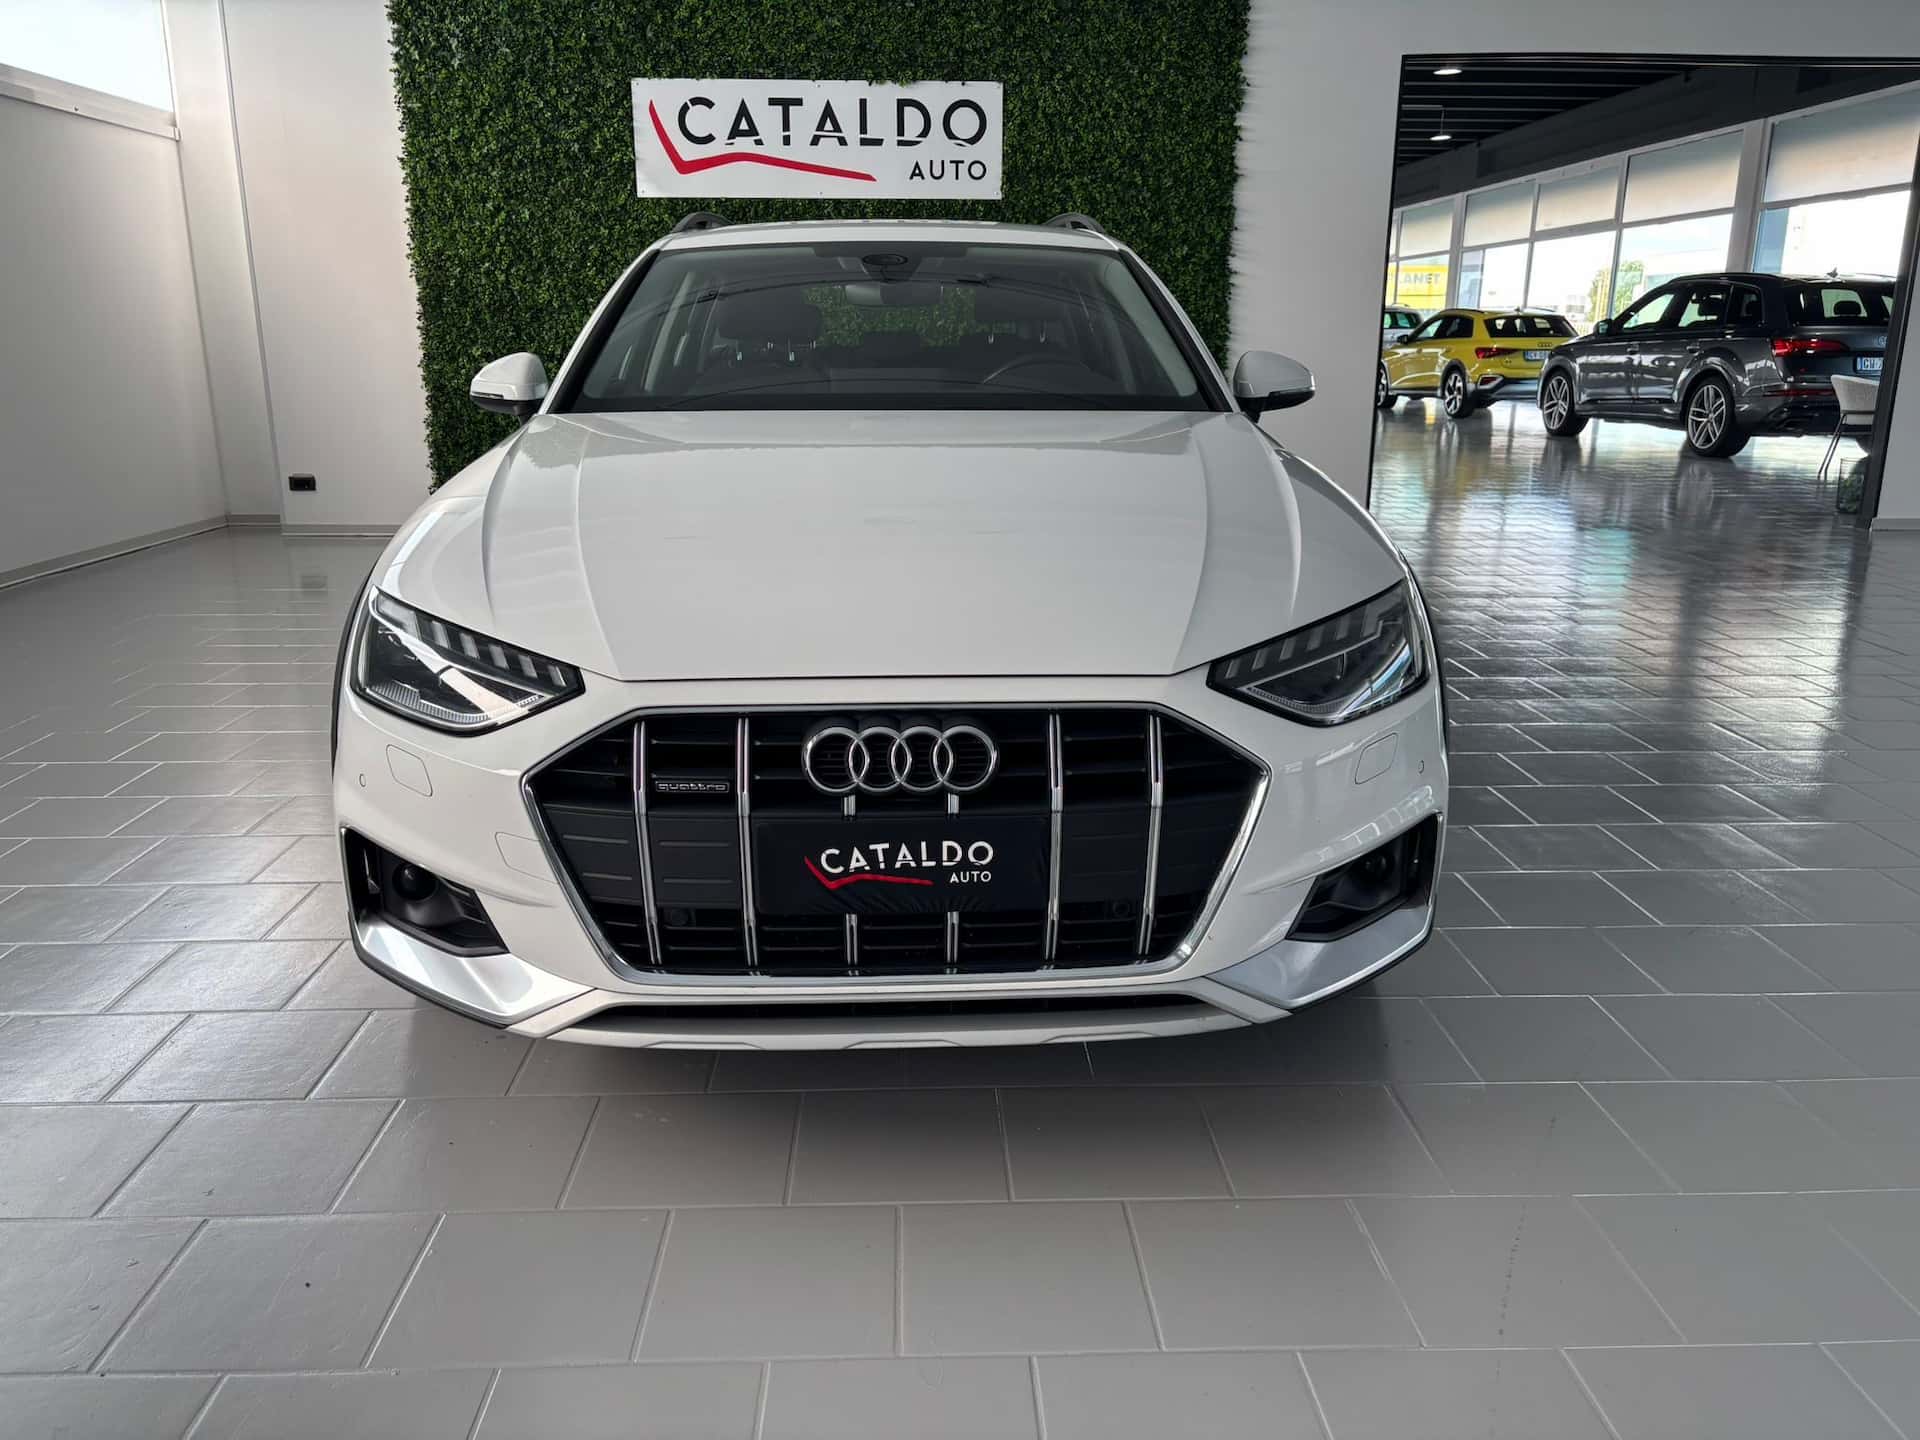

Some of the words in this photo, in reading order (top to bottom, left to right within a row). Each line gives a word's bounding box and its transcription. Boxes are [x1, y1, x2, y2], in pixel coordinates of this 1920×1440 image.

[678, 97, 987, 147] CATALDO
[909, 160, 987, 181] AUTO
[658, 783, 726, 791] quattro
[820, 840, 994, 873] CATALDO
[949, 870, 992, 884] AUTO
